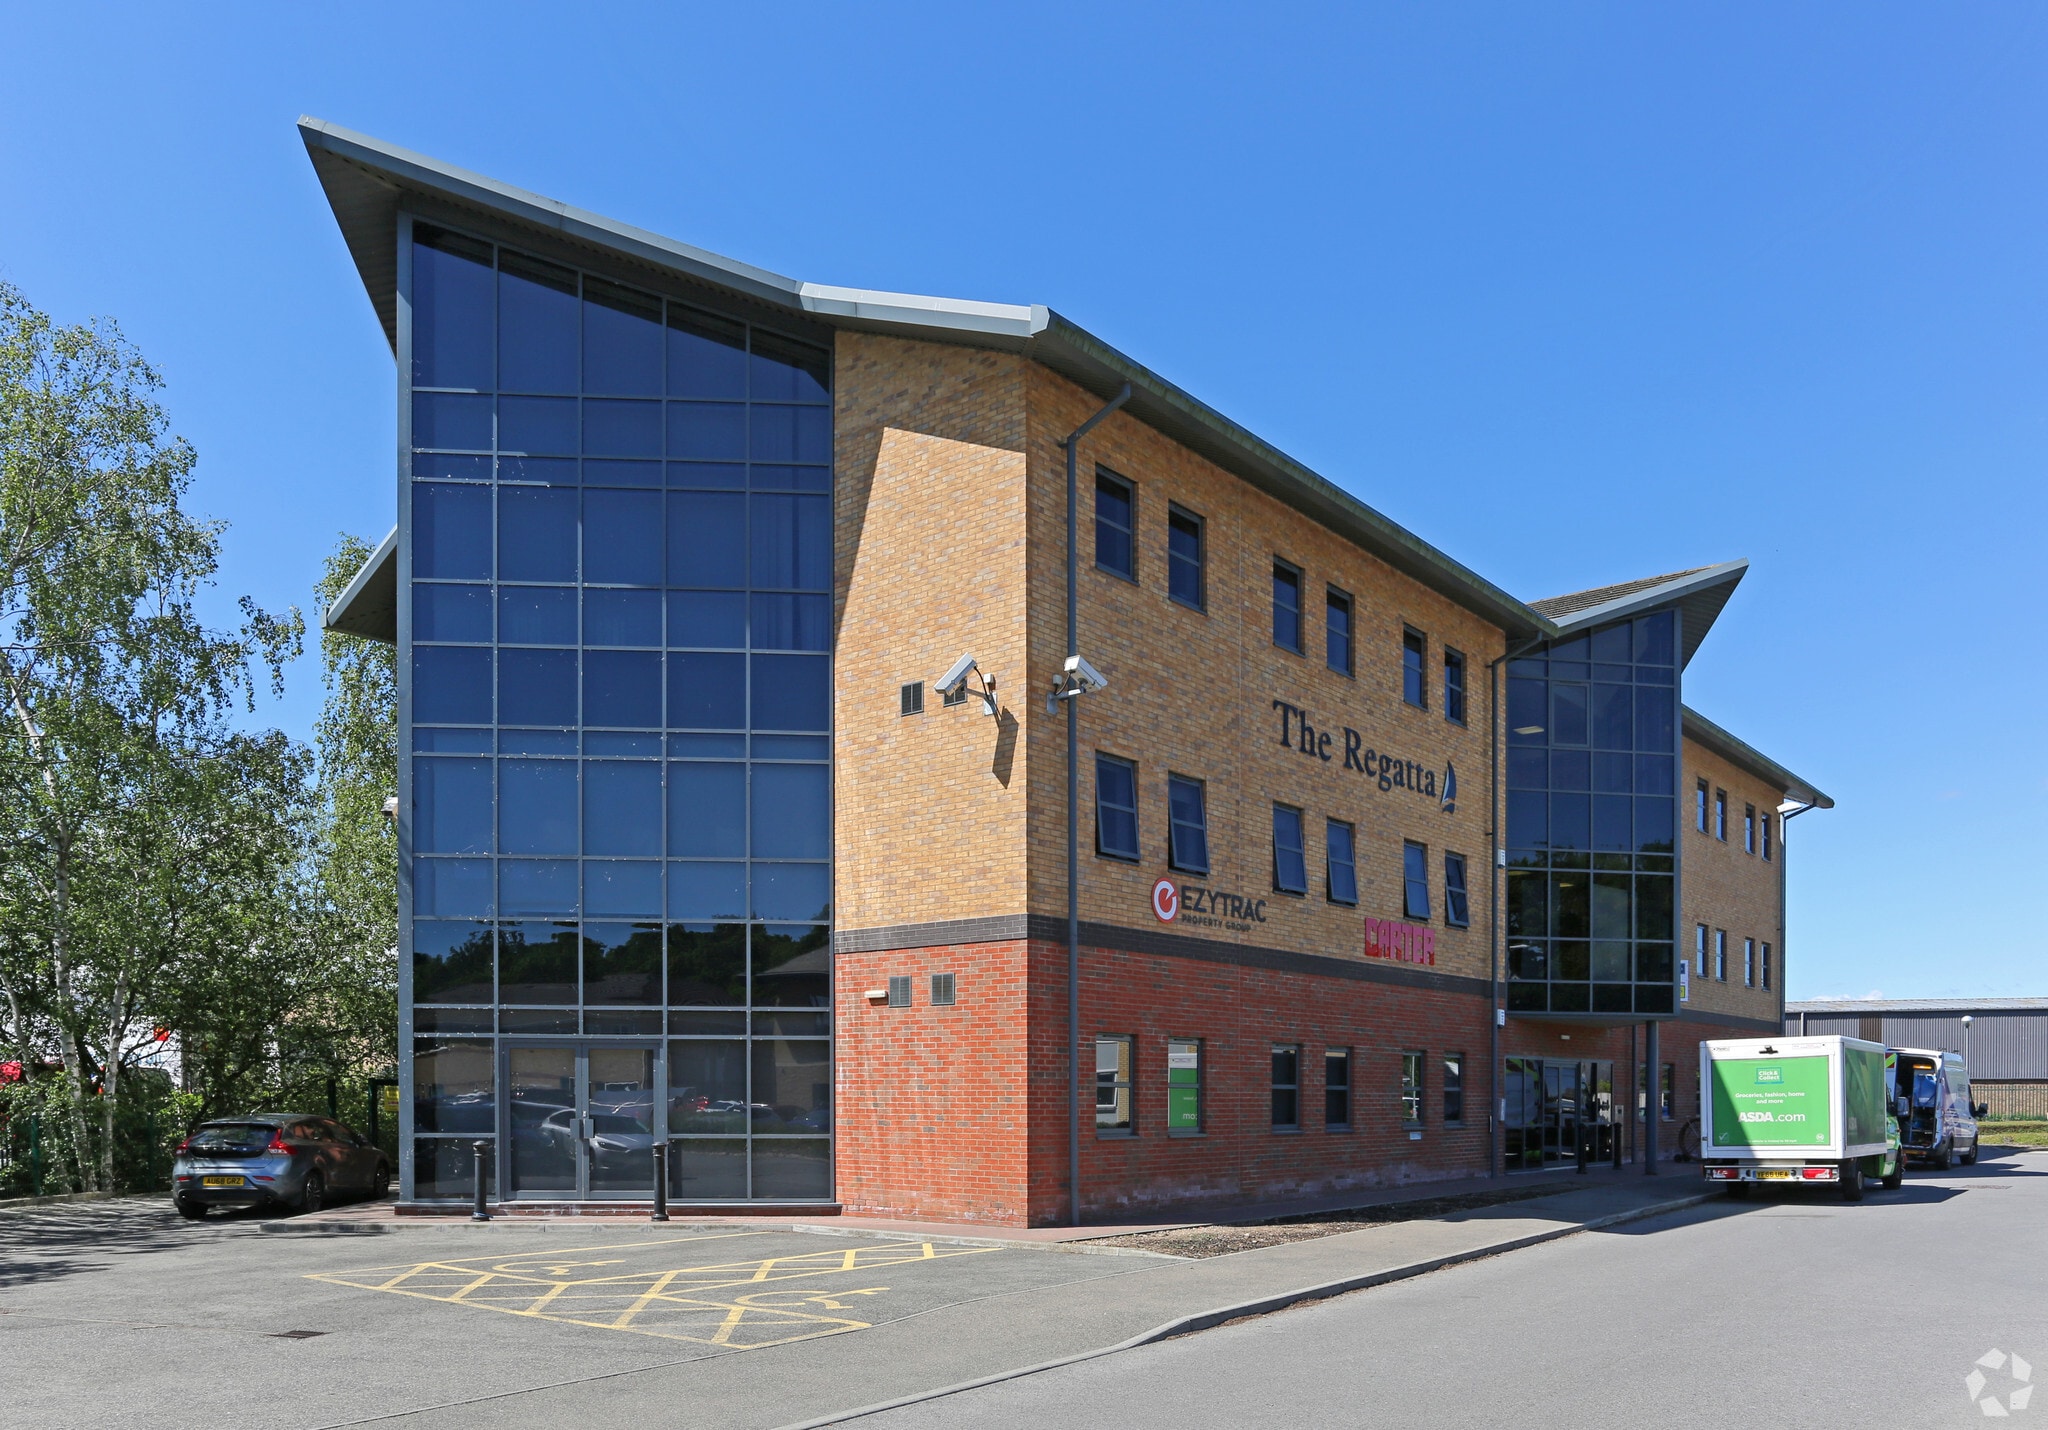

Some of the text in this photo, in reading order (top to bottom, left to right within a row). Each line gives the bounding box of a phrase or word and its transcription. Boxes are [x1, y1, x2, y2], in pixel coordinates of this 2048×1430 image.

[1272, 699, 1437, 798] The Regatta
[1180, 885, 1267, 923] EZYTRAC
[1181, 914, 1251, 932] PROPERTY GROUP
[1364, 916, 1436, 967] CARTER
